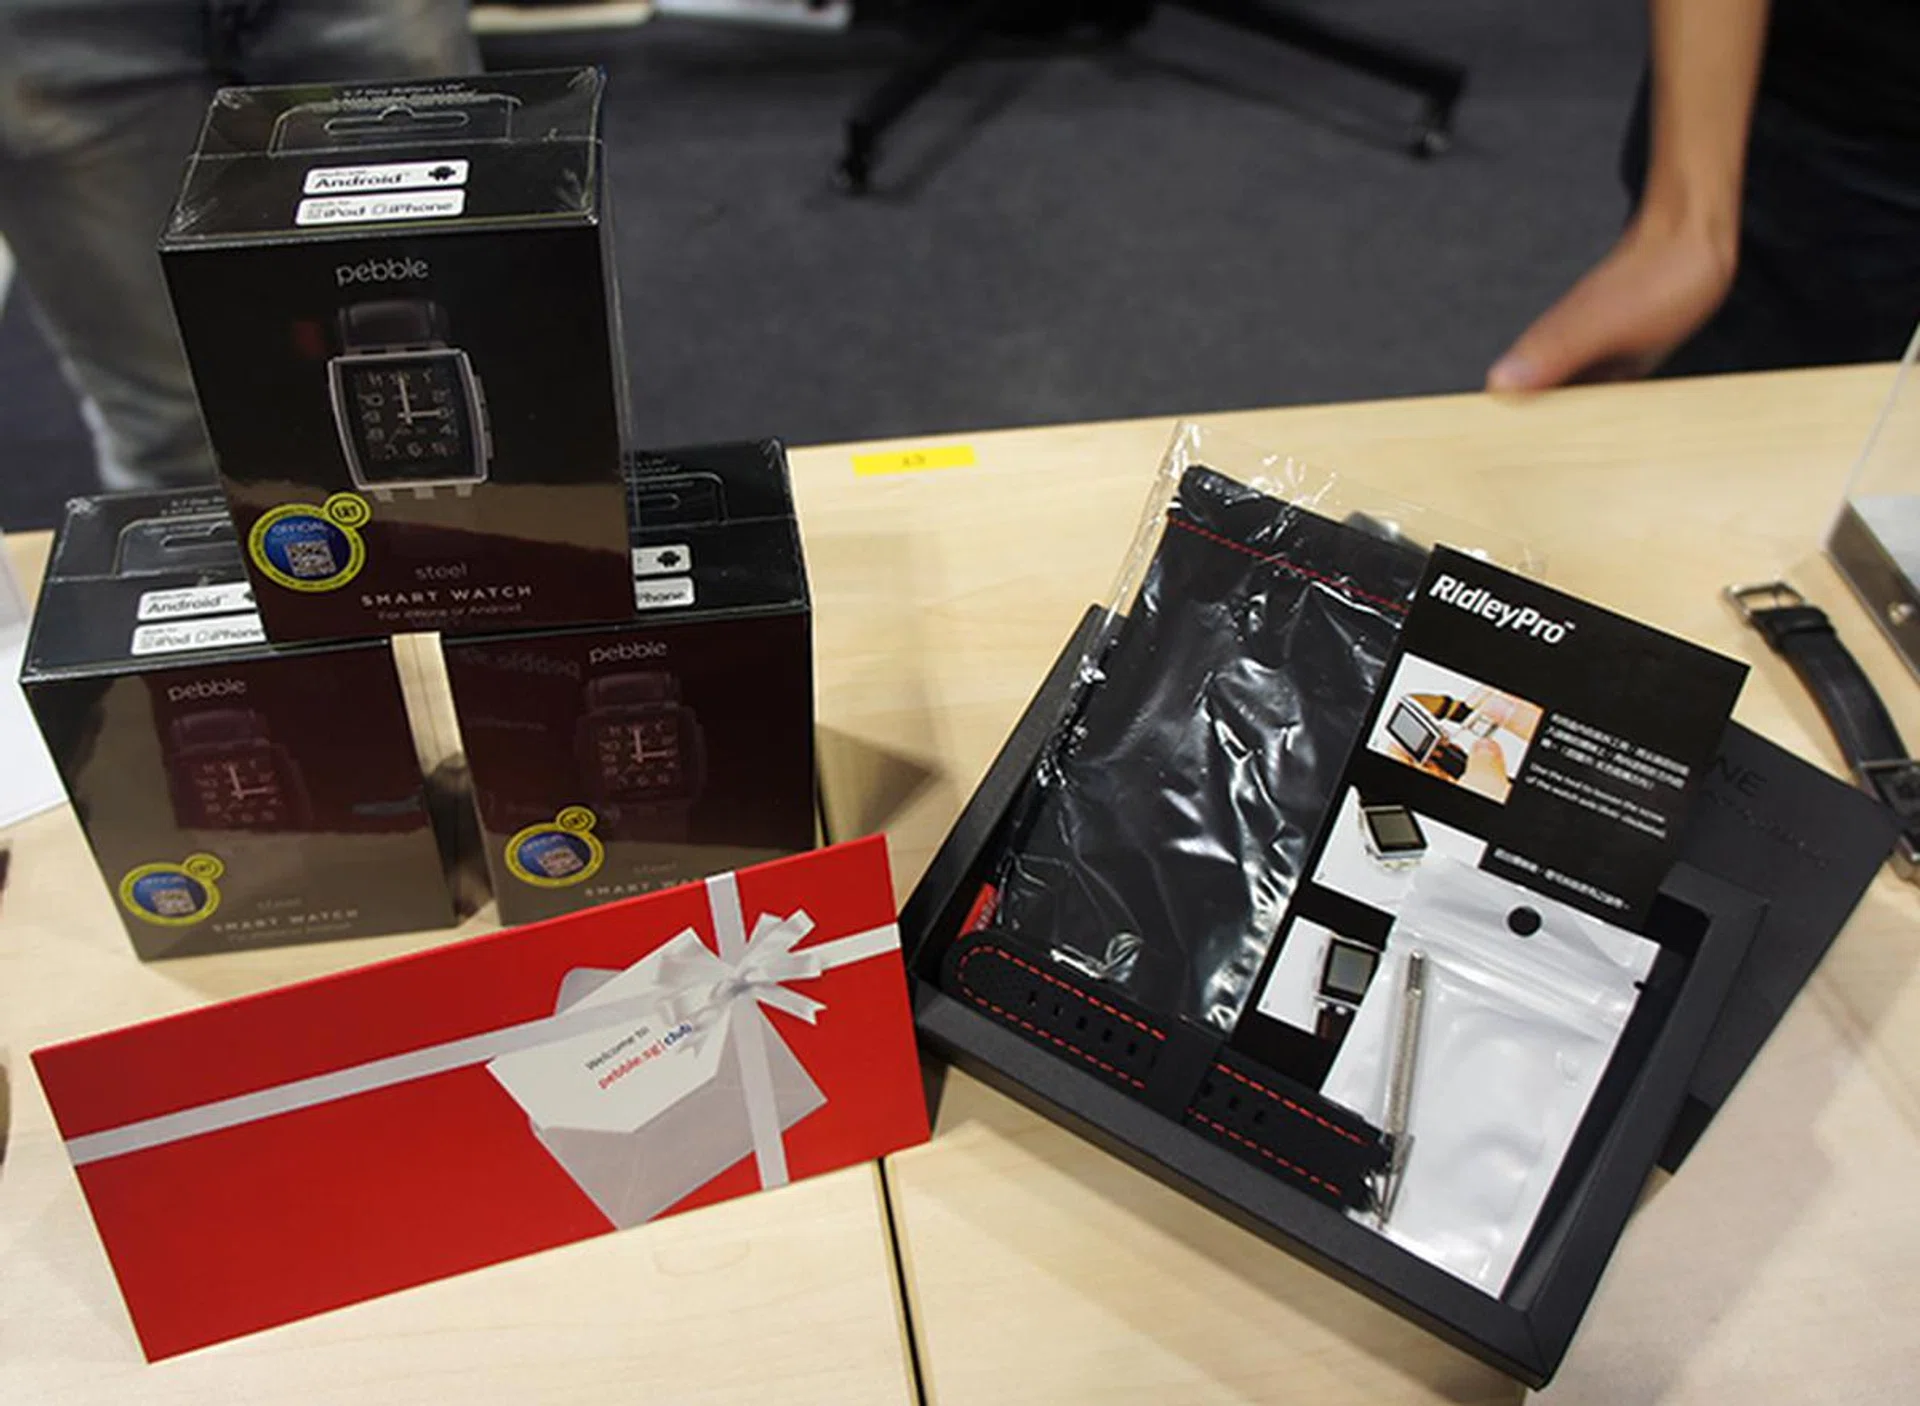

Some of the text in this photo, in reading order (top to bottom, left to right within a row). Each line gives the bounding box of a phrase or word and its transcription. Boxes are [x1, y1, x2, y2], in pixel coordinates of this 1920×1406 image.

[315, 173, 404, 189] Android
[336, 256, 428, 287] pebble
[147, 595, 222, 615] Android
[361, 584, 533, 608] SMART WATCH
[588, 640, 668, 665] pebble
[167, 677, 248, 702] pebble
[585, 1035, 635, 1071] Welcome
